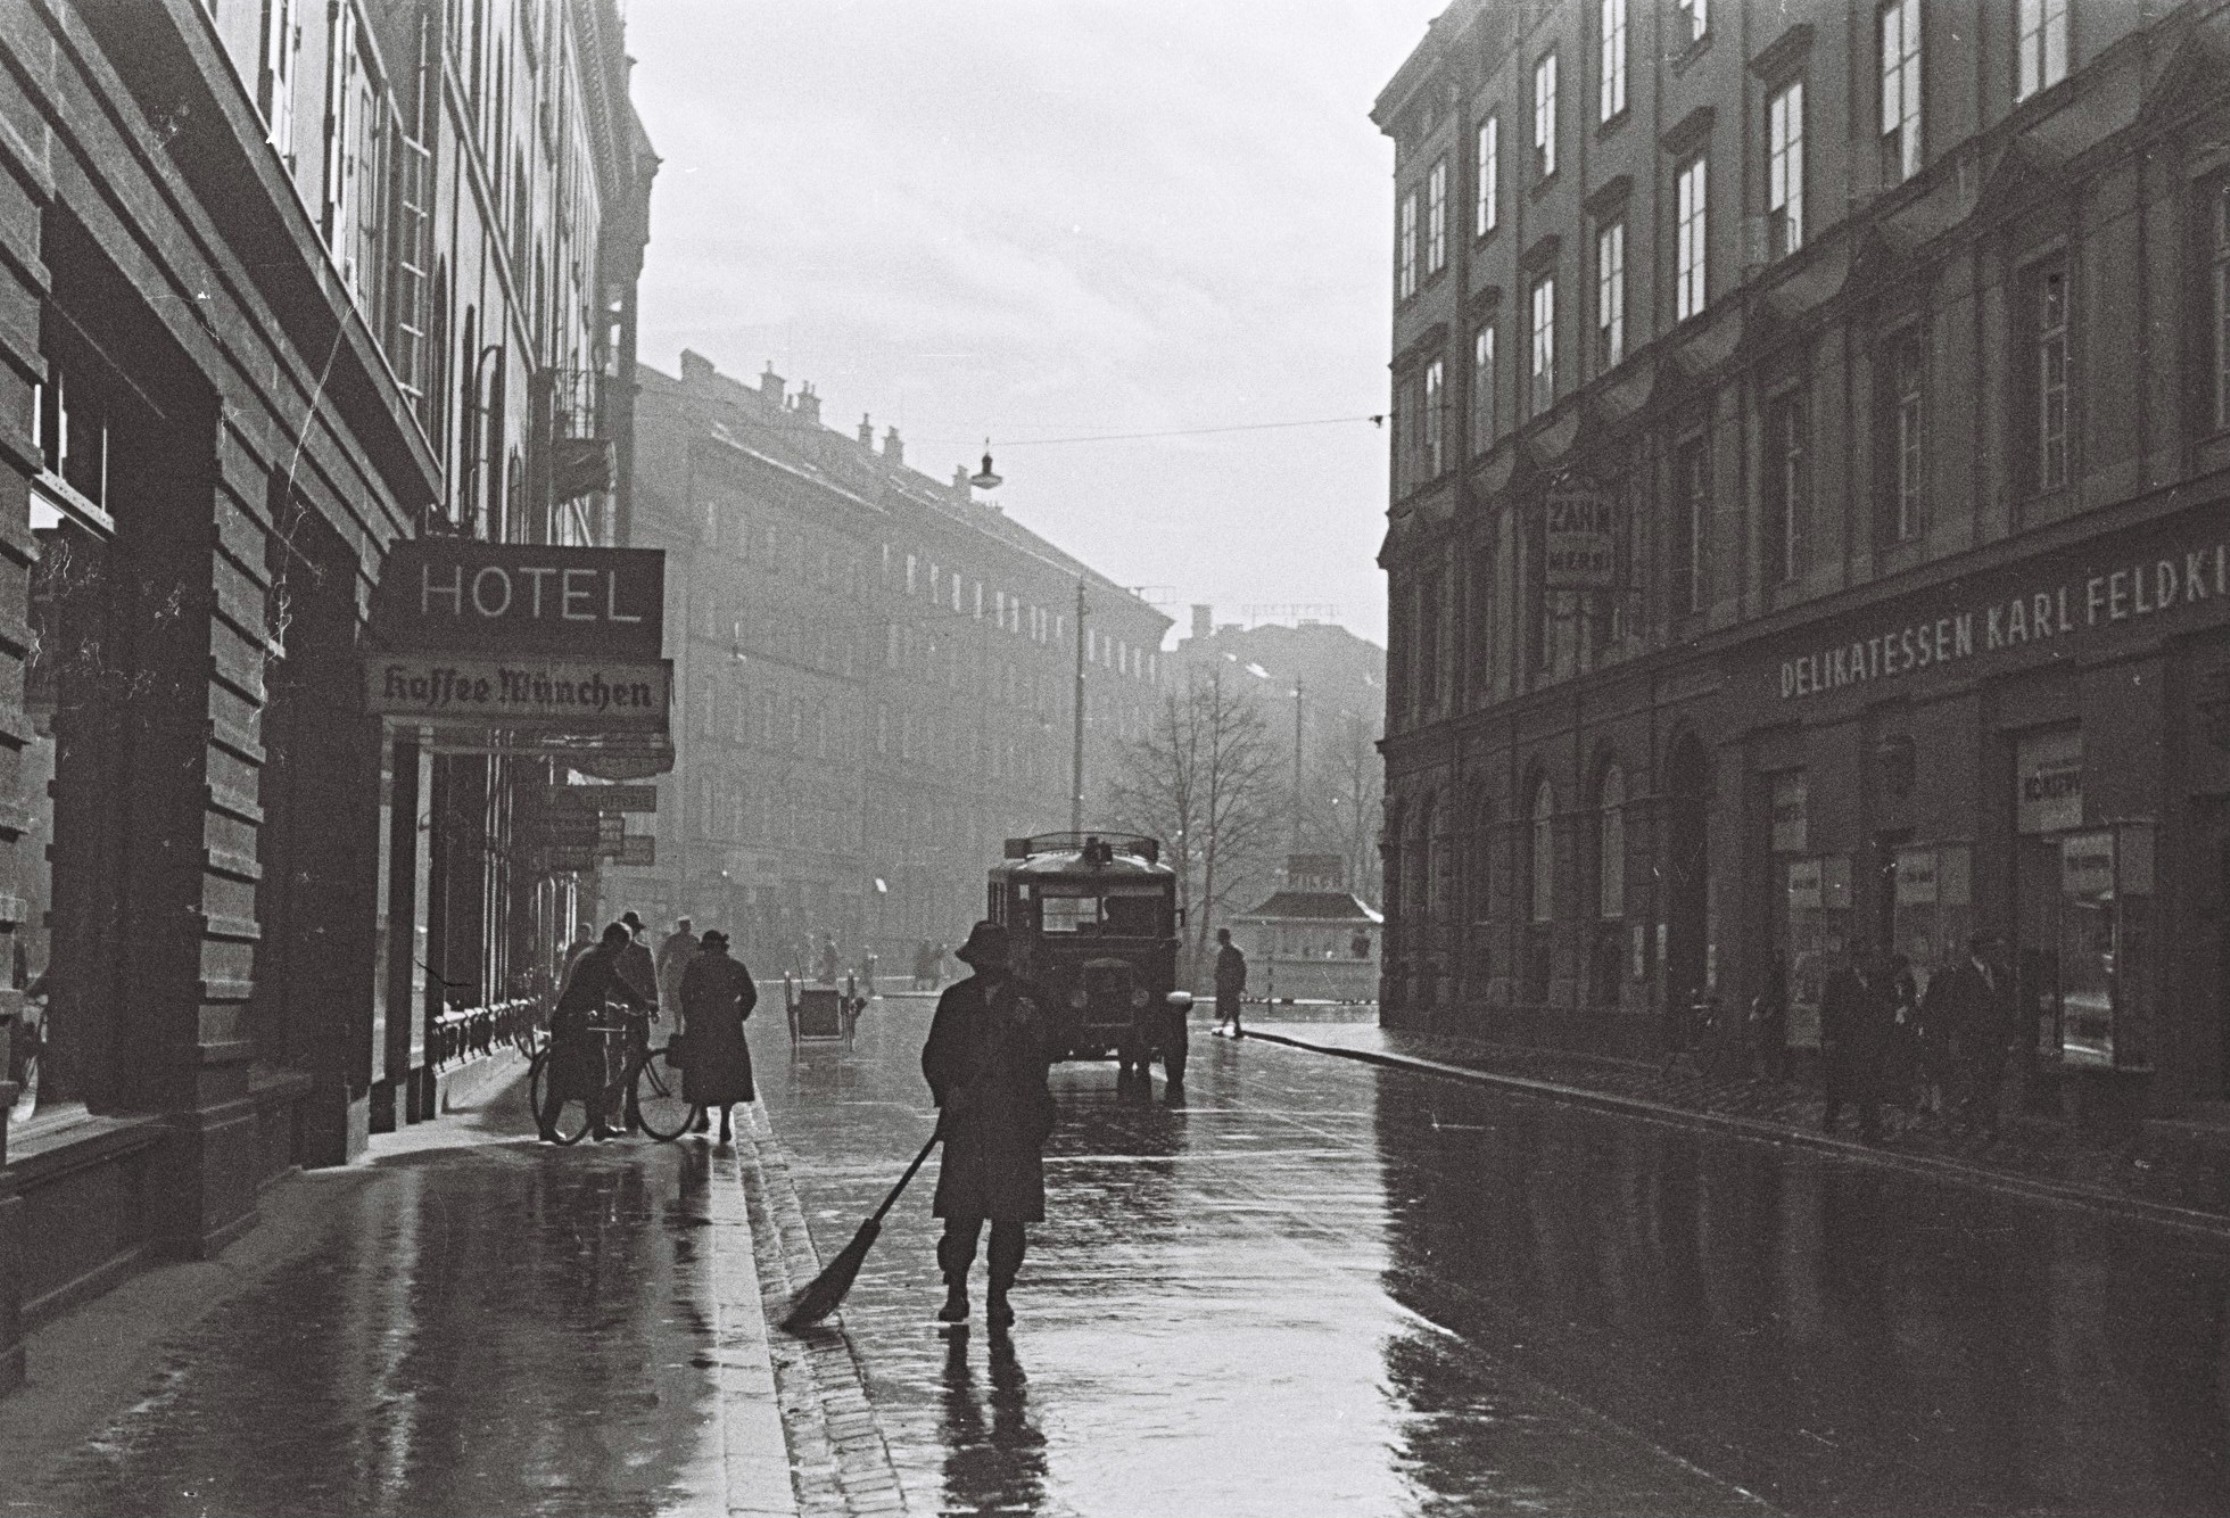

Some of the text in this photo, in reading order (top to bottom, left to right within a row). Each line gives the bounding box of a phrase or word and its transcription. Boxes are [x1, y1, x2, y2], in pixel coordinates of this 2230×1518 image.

[421, 565, 641, 622] HOTEL
[1780, 611, 1973, 698] DELIKATESSEN
[1987, 586, 2073, 650] KARL
[383, 664, 654, 712] Kaffee München
